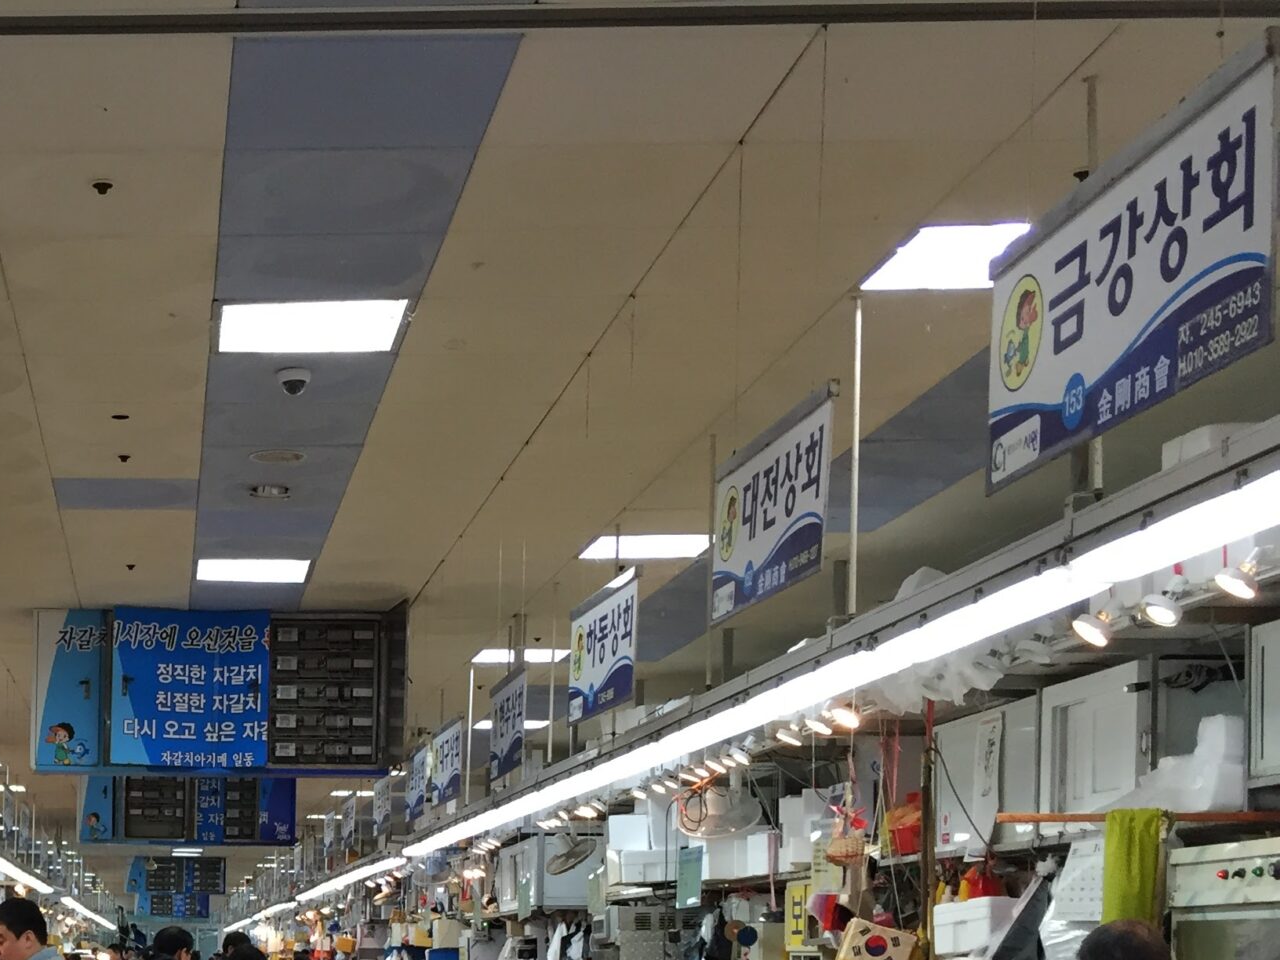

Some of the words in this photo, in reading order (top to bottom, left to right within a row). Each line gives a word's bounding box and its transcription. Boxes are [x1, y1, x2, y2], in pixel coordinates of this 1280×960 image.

[1048, 105, 1257, 355] 금강상회
[1200, 281, 1262, 336] 245-6943
[1065, 386, 1083, 417] 153
[1096, 354, 1170, 425] 金剛商會
[741, 423, 825, 542] 대전상회
[55, 620, 179, 652] 자갈치시장에
[183, 625, 259, 653] 오신것을
[586, 594, 635, 668] 하동상회
[156, 663, 206, 685] 정직한
[213, 664, 262, 686] 자갈치
[155, 691, 206, 713] 친절한
[212, 692, 261, 714] 자갈치
[123, 718, 156, 740] 다시
[163, 719, 196, 740] 오고
[203, 720, 236, 742] 싶은
[232, 752, 255, 767] 일동
[199, 778, 220, 791] 갈치
[199, 795, 220, 808] 갈치
